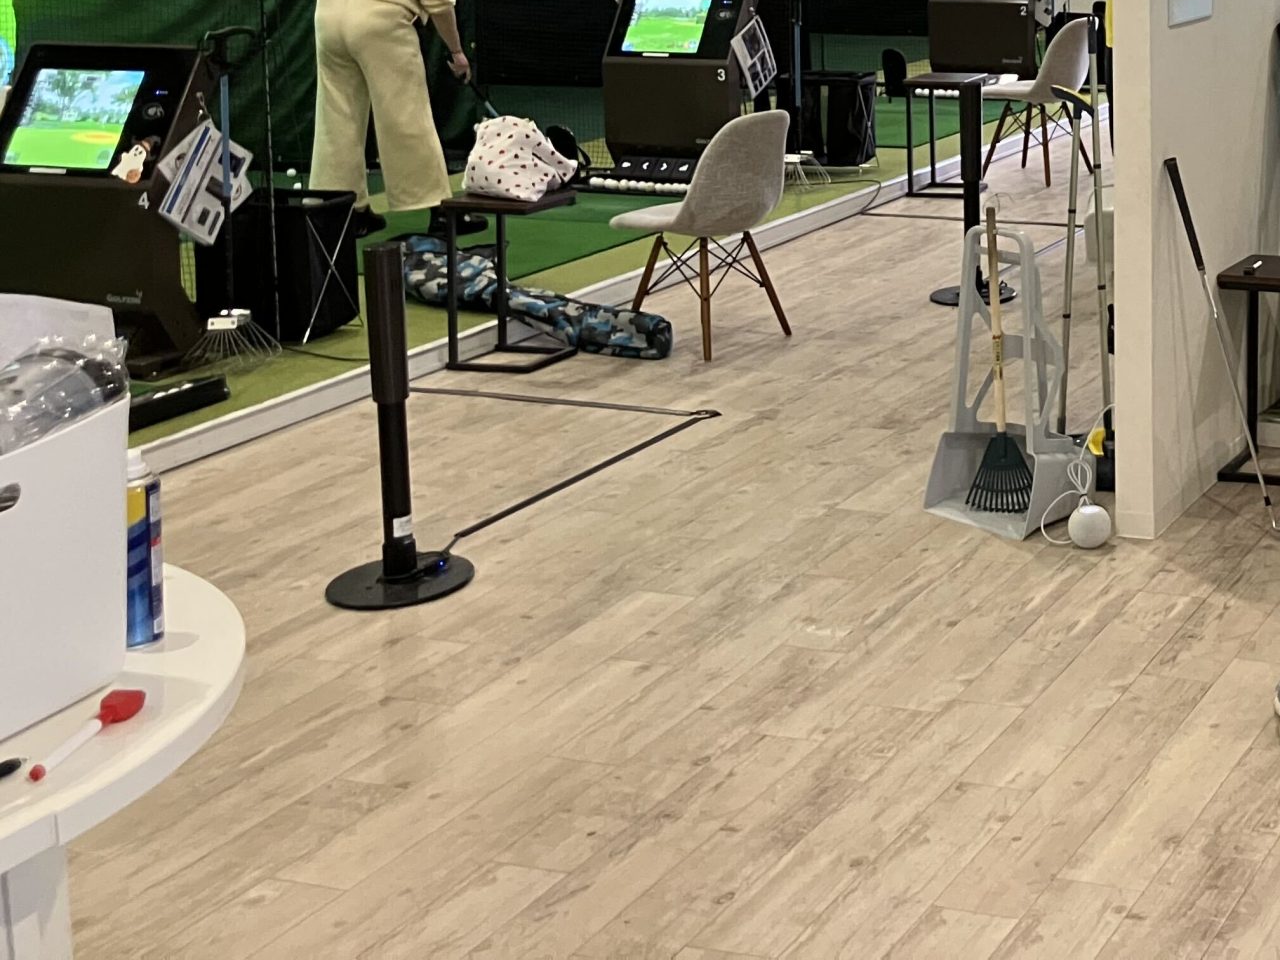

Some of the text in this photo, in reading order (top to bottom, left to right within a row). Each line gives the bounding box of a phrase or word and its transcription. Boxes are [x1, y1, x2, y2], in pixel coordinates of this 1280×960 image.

[1020, 5, 1028, 16] 2
[717, 68, 726, 82] 3
[138, 191, 150, 210] 4
